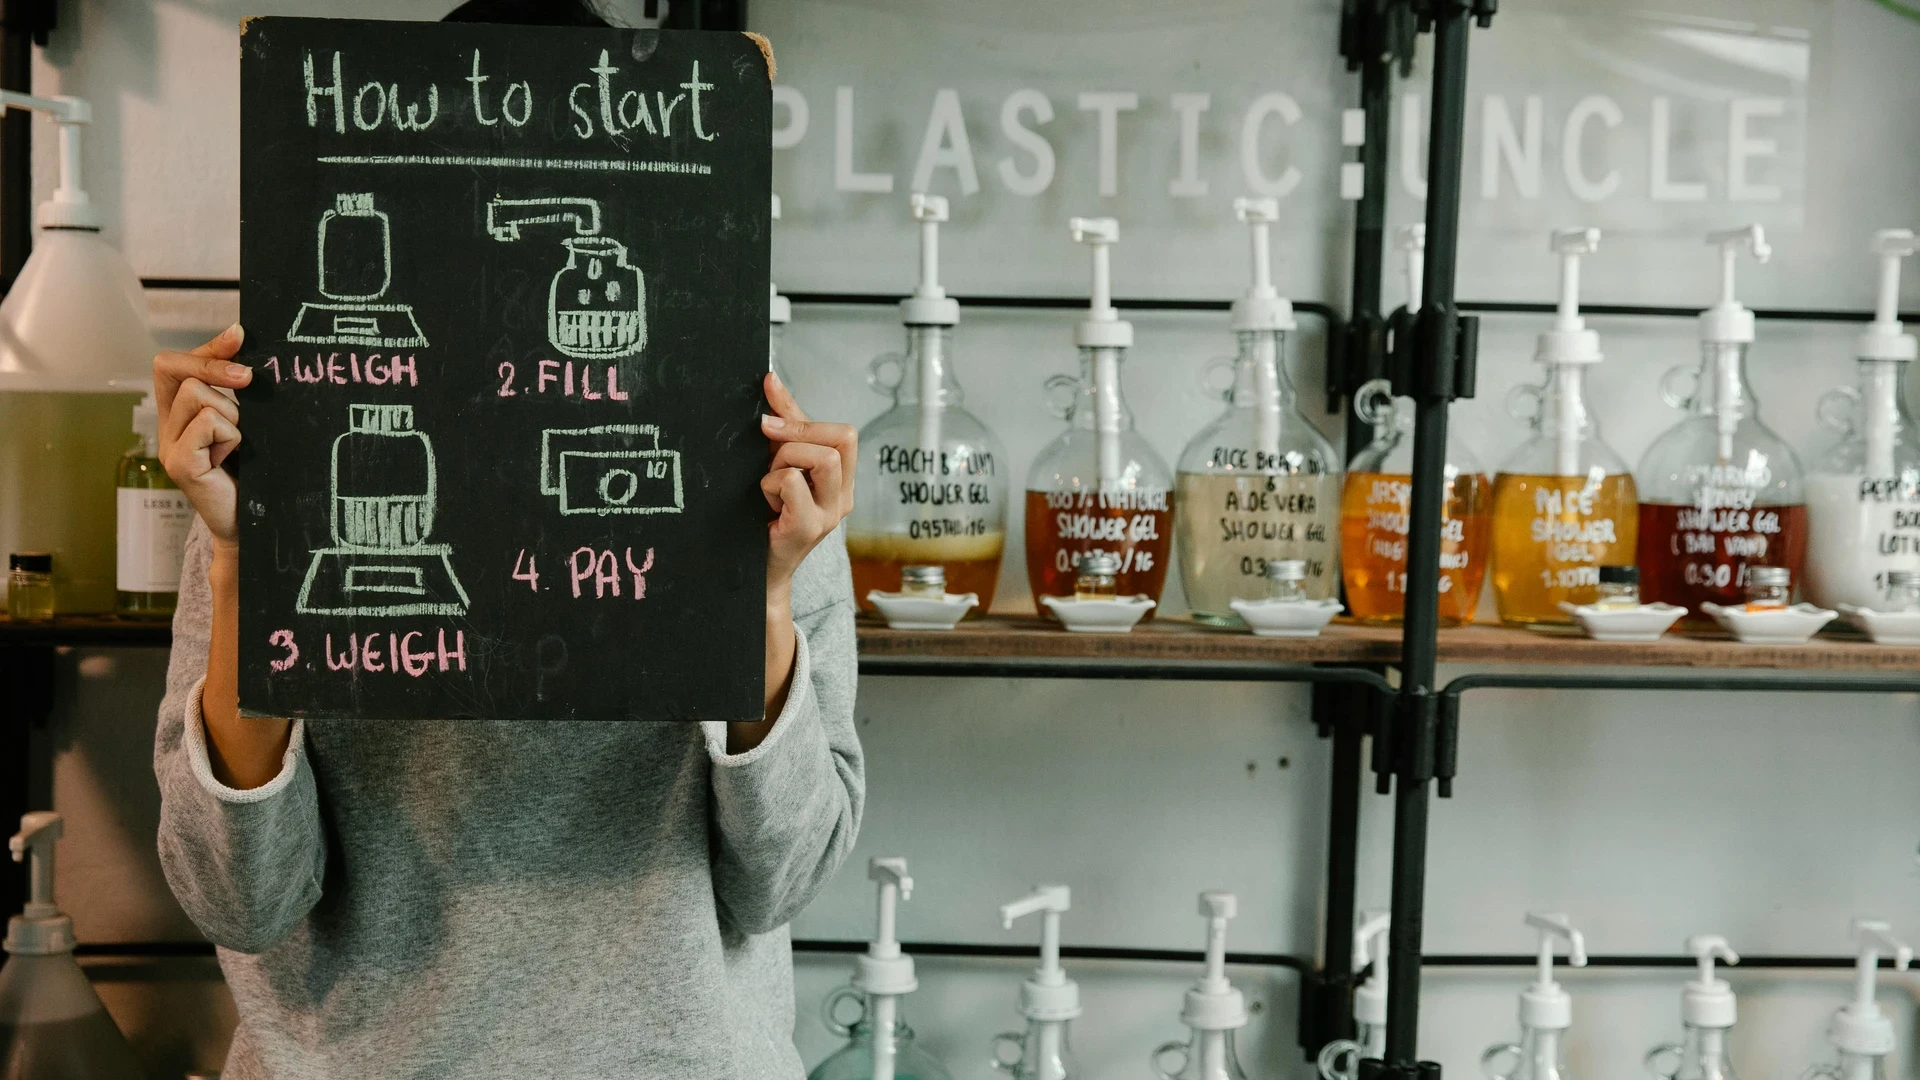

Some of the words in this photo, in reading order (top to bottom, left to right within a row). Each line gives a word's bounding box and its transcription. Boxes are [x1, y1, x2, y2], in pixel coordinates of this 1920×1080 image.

[304, 51, 439, 134] How
[465, 48, 532, 127] to
[569, 48, 715, 142] start
[647, 461, 668, 479] 10
[879, 444, 934, 476] PEACH
[956, 452, 995, 476] LUM
[1212, 446, 1249, 468] RICE
[1256, 451, 1302, 473] BRA
[900, 481, 964, 506] SHOWER
[969, 482, 990, 504] GEL
[1056, 511, 1127, 541] SHOWER
[1129, 514, 1159, 543] GEL
[1531, 517, 1617, 544] SHOWER
[1554, 541, 1595, 563] GEL
[567, 546, 656, 601] PAY
[325, 627, 467, 678] WEIGH
